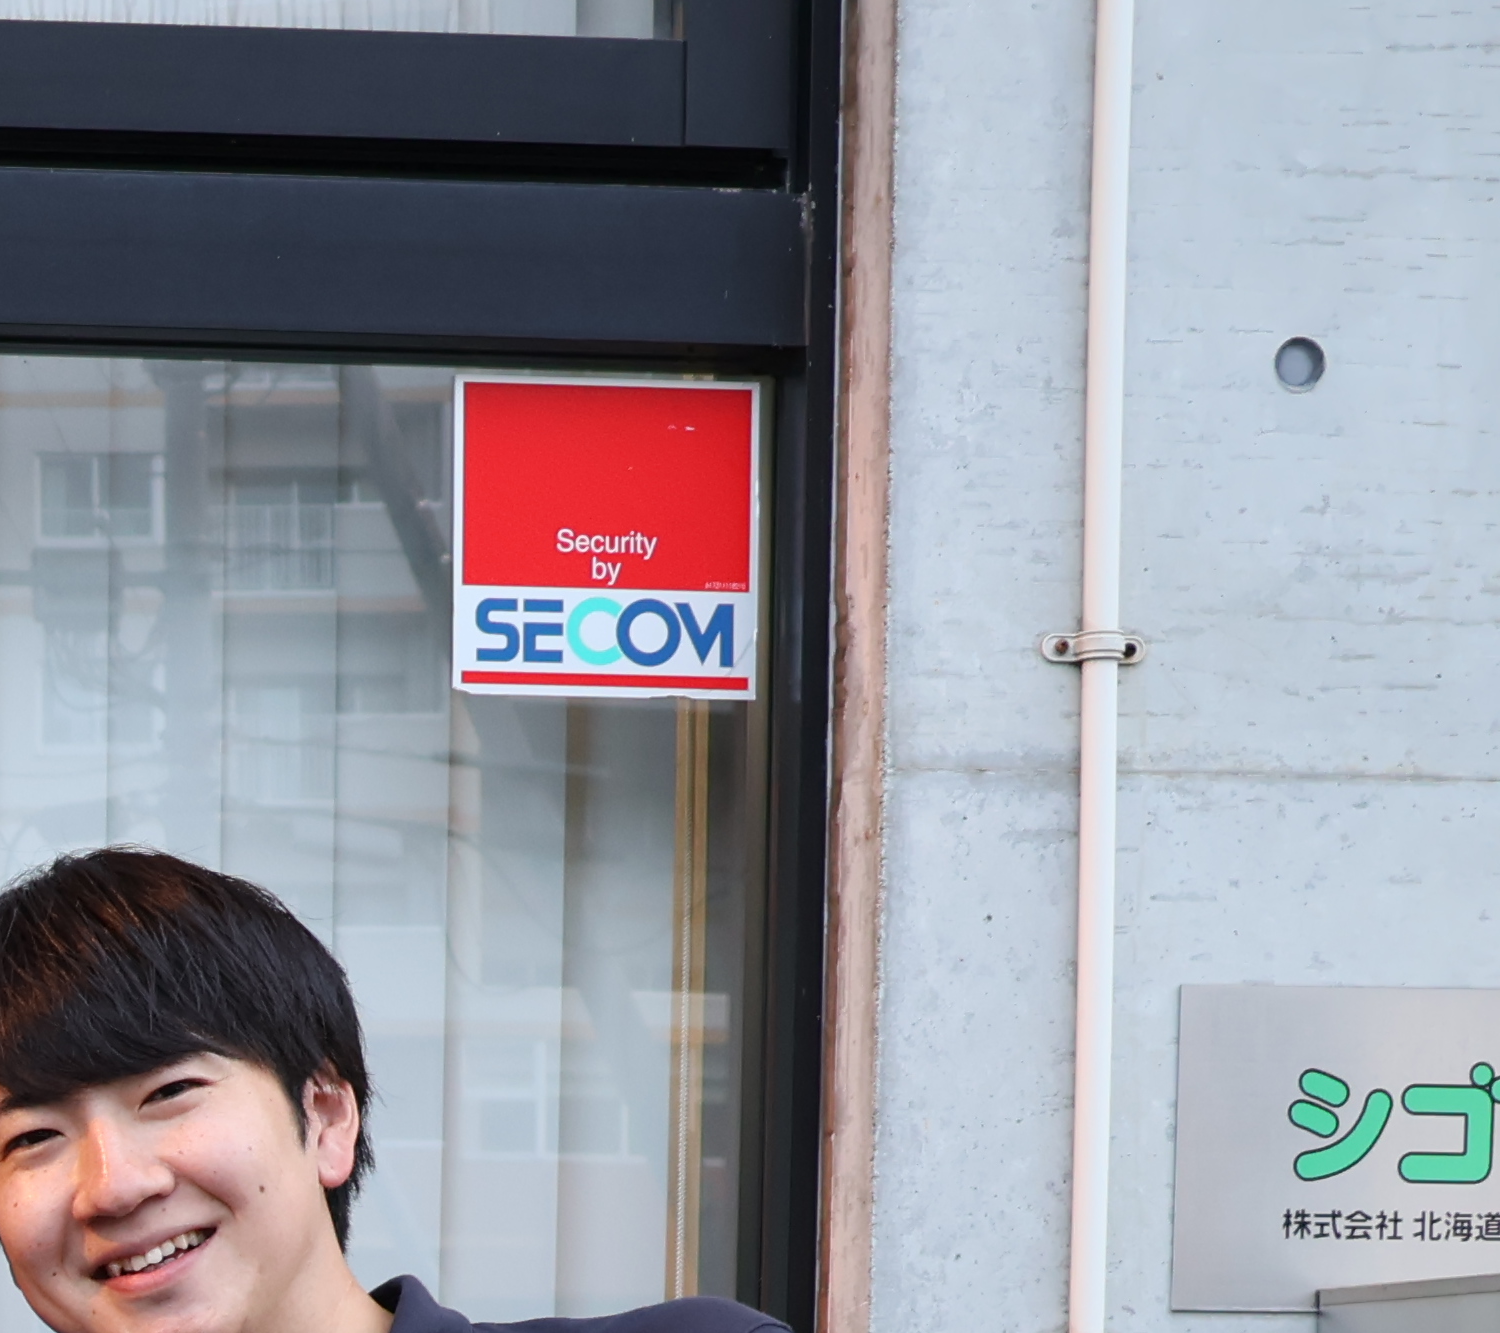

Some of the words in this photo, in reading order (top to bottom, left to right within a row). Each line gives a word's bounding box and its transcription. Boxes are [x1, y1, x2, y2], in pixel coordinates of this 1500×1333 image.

[556, 528, 658, 560] Security
[591, 556, 622, 585] by
[475, 596, 735, 668] SECOM
[1287, 1061, 1500, 1185] シゴ
[1282, 1208, 1404, 1240] 株式会社
[1412, 1210, 1500, 1242] 北海道
